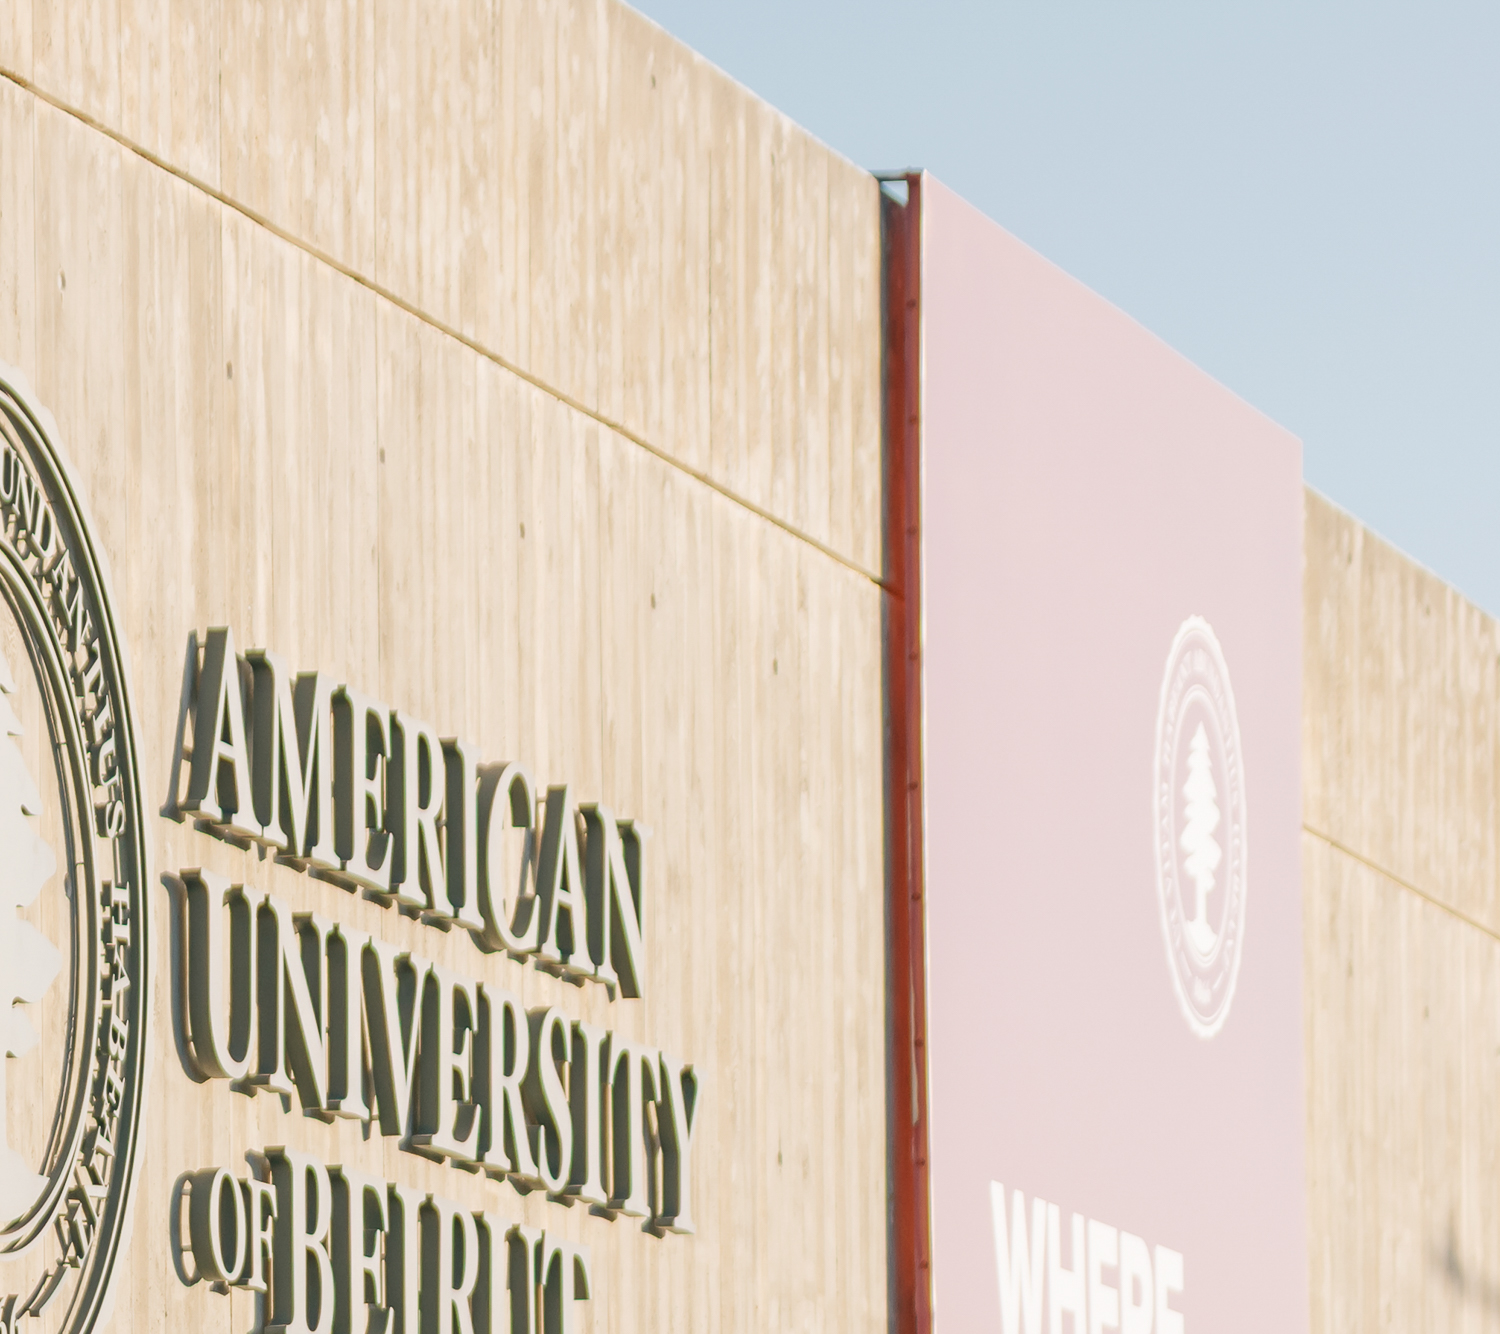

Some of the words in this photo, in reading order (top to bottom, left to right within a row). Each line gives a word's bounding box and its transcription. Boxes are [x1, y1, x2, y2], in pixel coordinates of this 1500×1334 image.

[196, 626, 652, 1000] AMERICAN
[196, 867, 702, 1234] UNIVERSITY
[198, 1167, 277, 1292] OF
